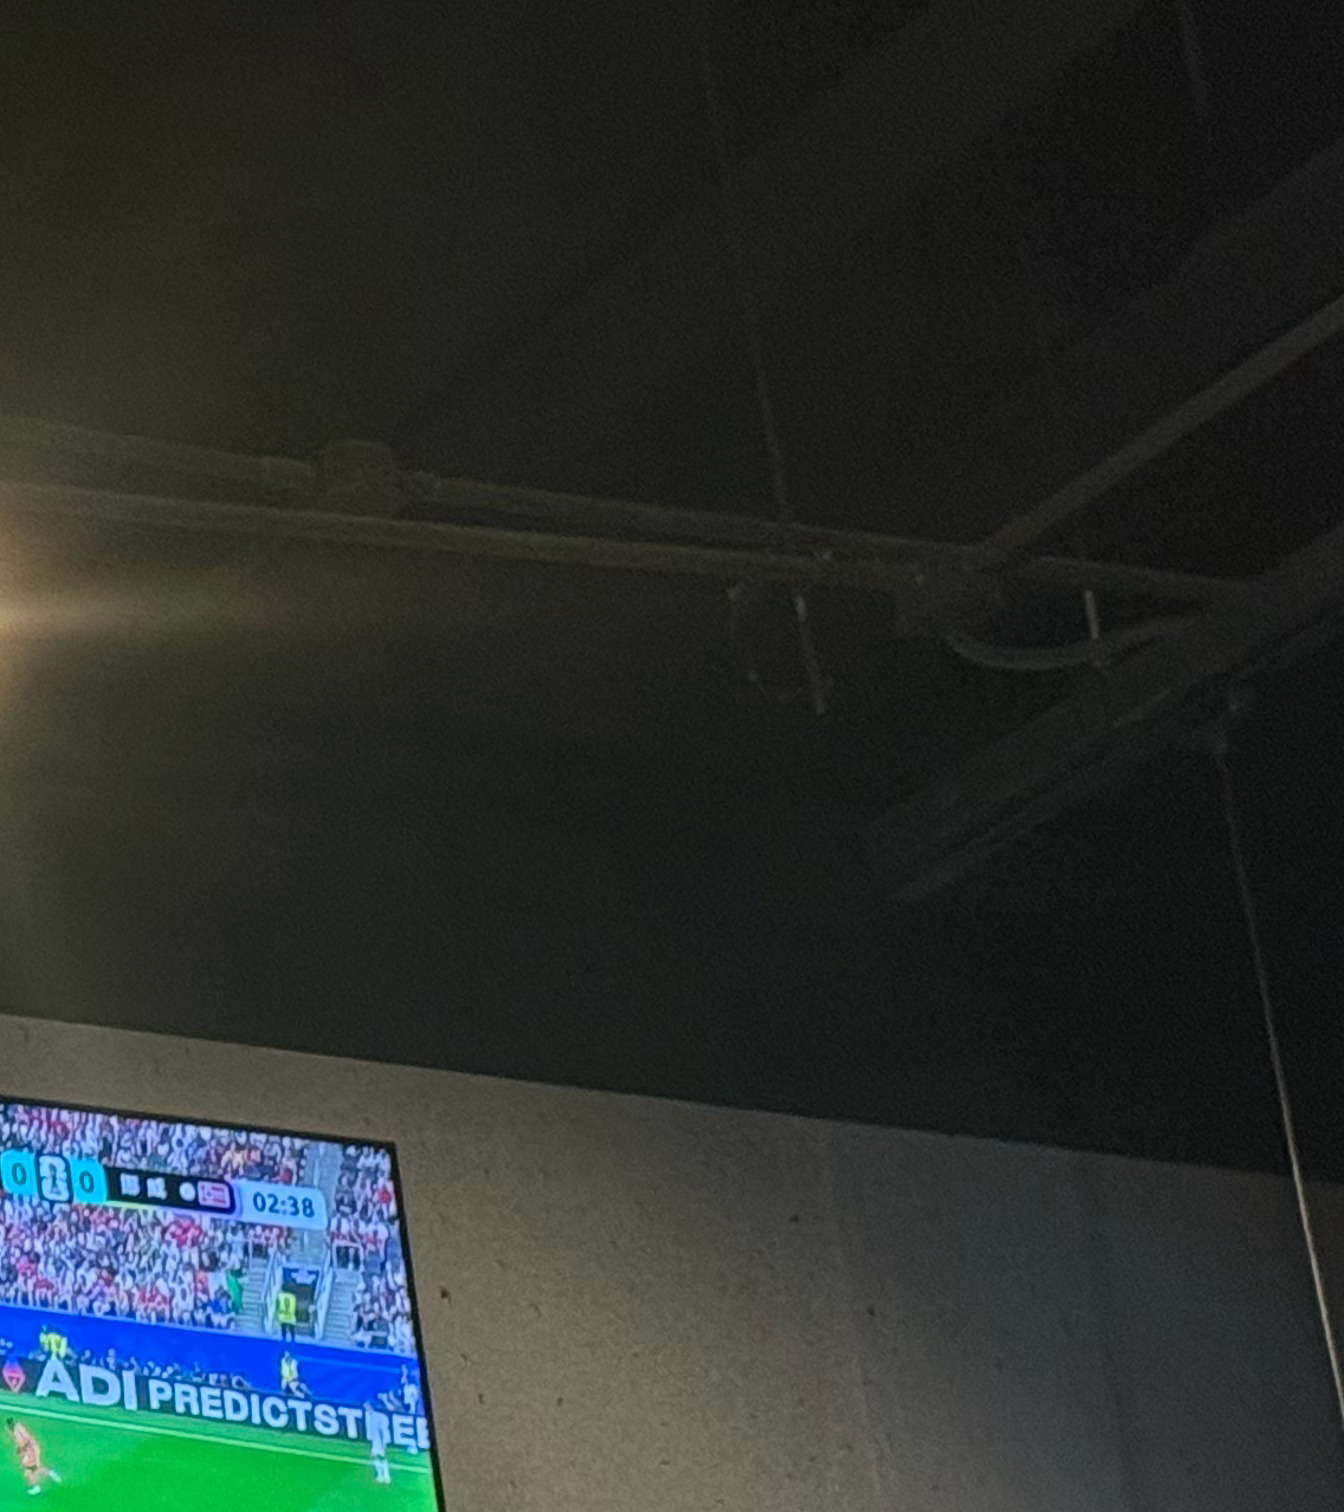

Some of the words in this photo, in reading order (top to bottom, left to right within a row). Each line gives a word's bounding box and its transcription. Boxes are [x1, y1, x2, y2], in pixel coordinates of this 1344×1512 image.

[12, 1163, 26, 1185] 0
[79, 1170, 94, 1194] 0
[252, 1191, 315, 1218] 02:38
[35, 1359, 138, 1411] ADI
